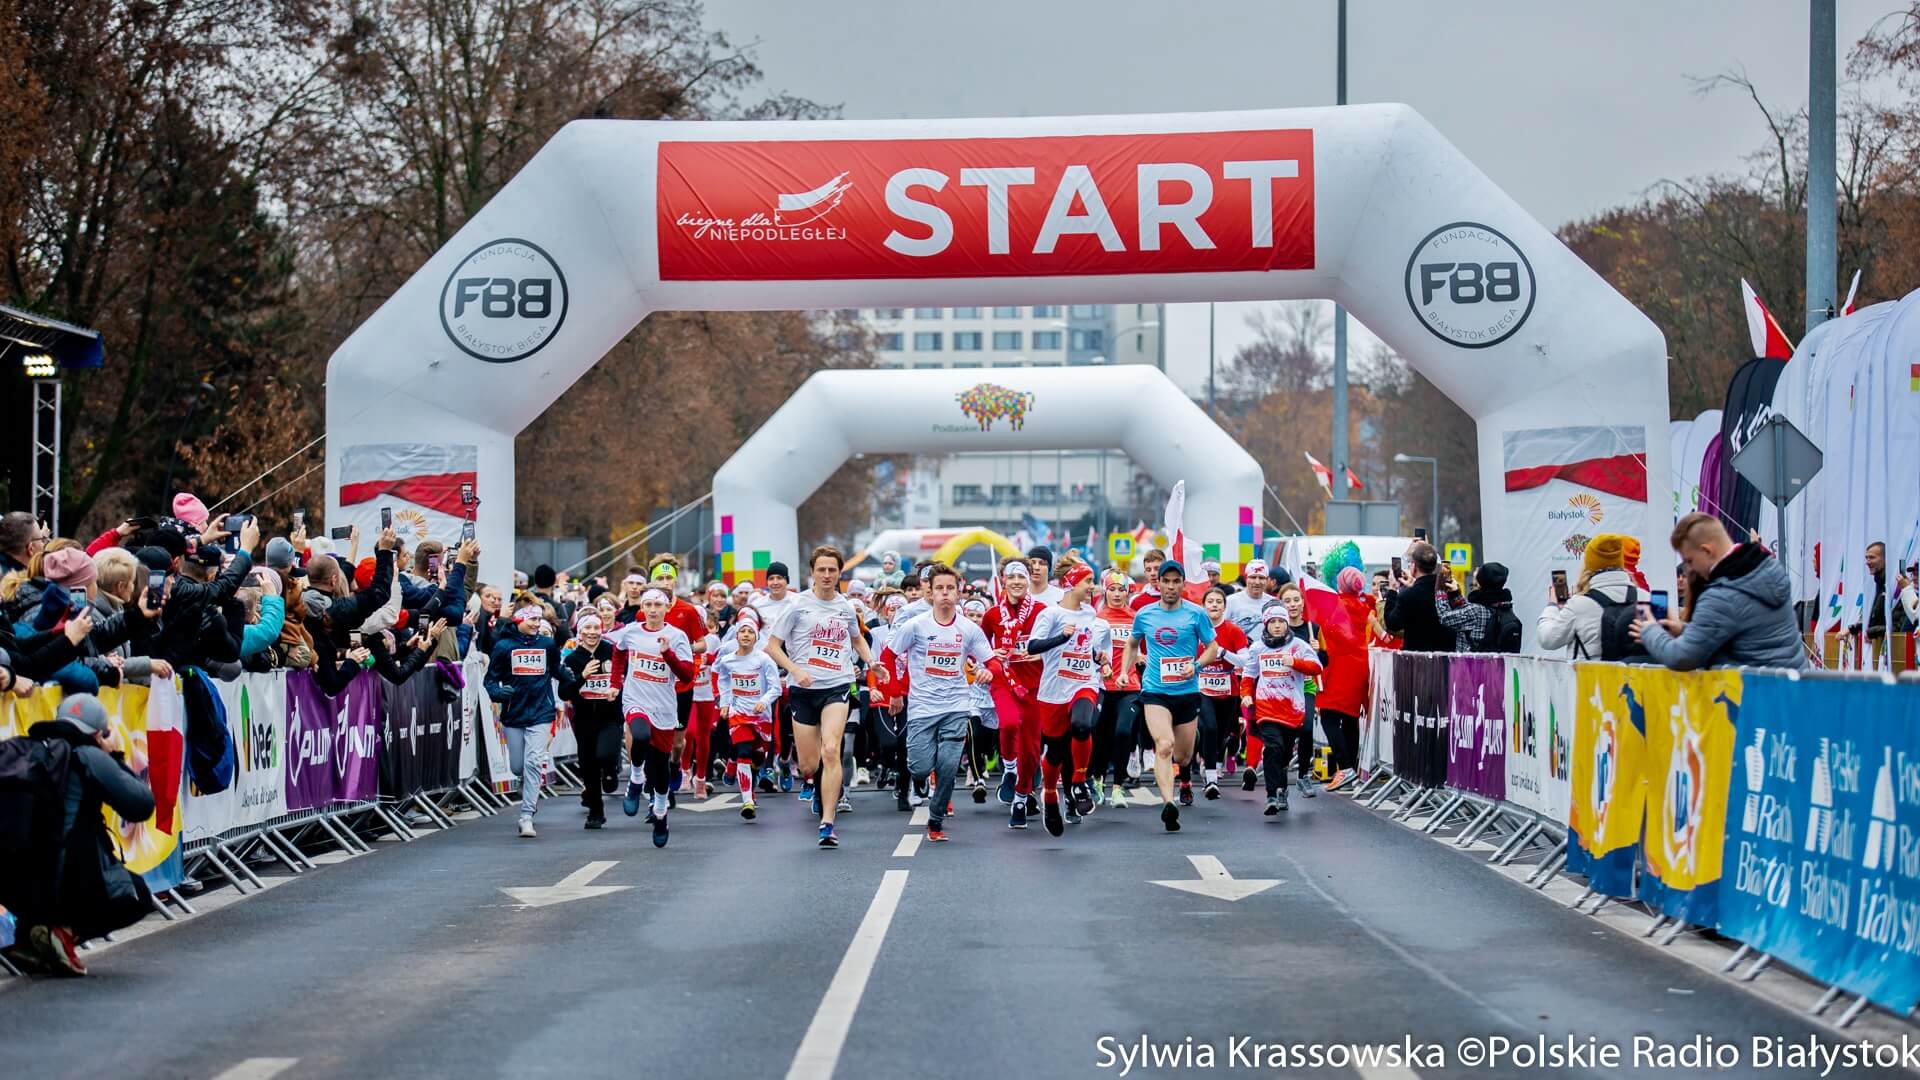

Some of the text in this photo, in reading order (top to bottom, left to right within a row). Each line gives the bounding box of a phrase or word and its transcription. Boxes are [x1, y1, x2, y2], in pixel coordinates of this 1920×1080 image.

[883, 160, 1299, 256] START
[677, 211, 773, 239] biegnę dla
[710, 227, 847, 241] NIEPODLEGŁEJ
[1432, 230, 1499, 249] FUNDACJA
[472, 246, 536, 265] FUNDACJA
[1428, 307, 1519, 340] BIAŁYSTOK BIEGA
[457, 324, 548, 354] BIAŁYSTOK BIEGA
[1548, 509, 1585, 521] Białystok
[1113, 628, 1132, 637] 115
[816, 646, 840, 659] 1372
[517, 654, 542, 664] 1344
[931, 655, 957, 666] 1092
[1066, 658, 1091, 669] 1200
[1265, 659, 1285, 667] 104
[639, 659, 666, 672] 1154
[1166, 663, 1185, 672] 115
[584, 679, 608, 688] 1343
[735, 678, 756, 687] 1315
[1203, 678, 1226, 686] 1402
